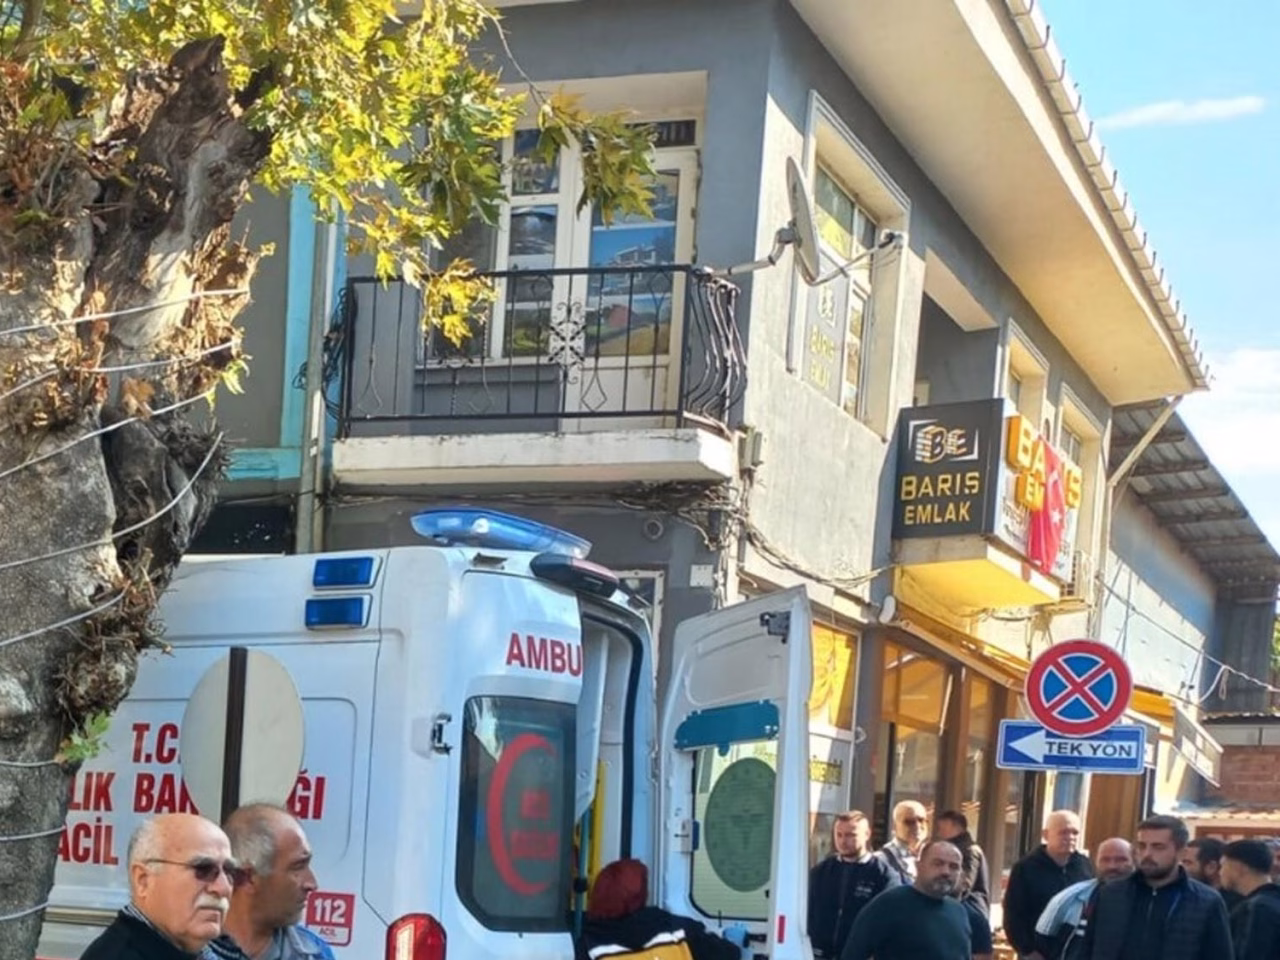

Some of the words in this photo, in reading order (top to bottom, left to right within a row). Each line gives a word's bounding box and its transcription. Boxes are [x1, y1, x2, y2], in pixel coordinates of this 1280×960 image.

[904, 502, 970, 525] EMLAK
[506, 633, 582, 677] AMBU
[1045, 741, 1083, 756] TEK
[314, 897, 347, 925] 112
